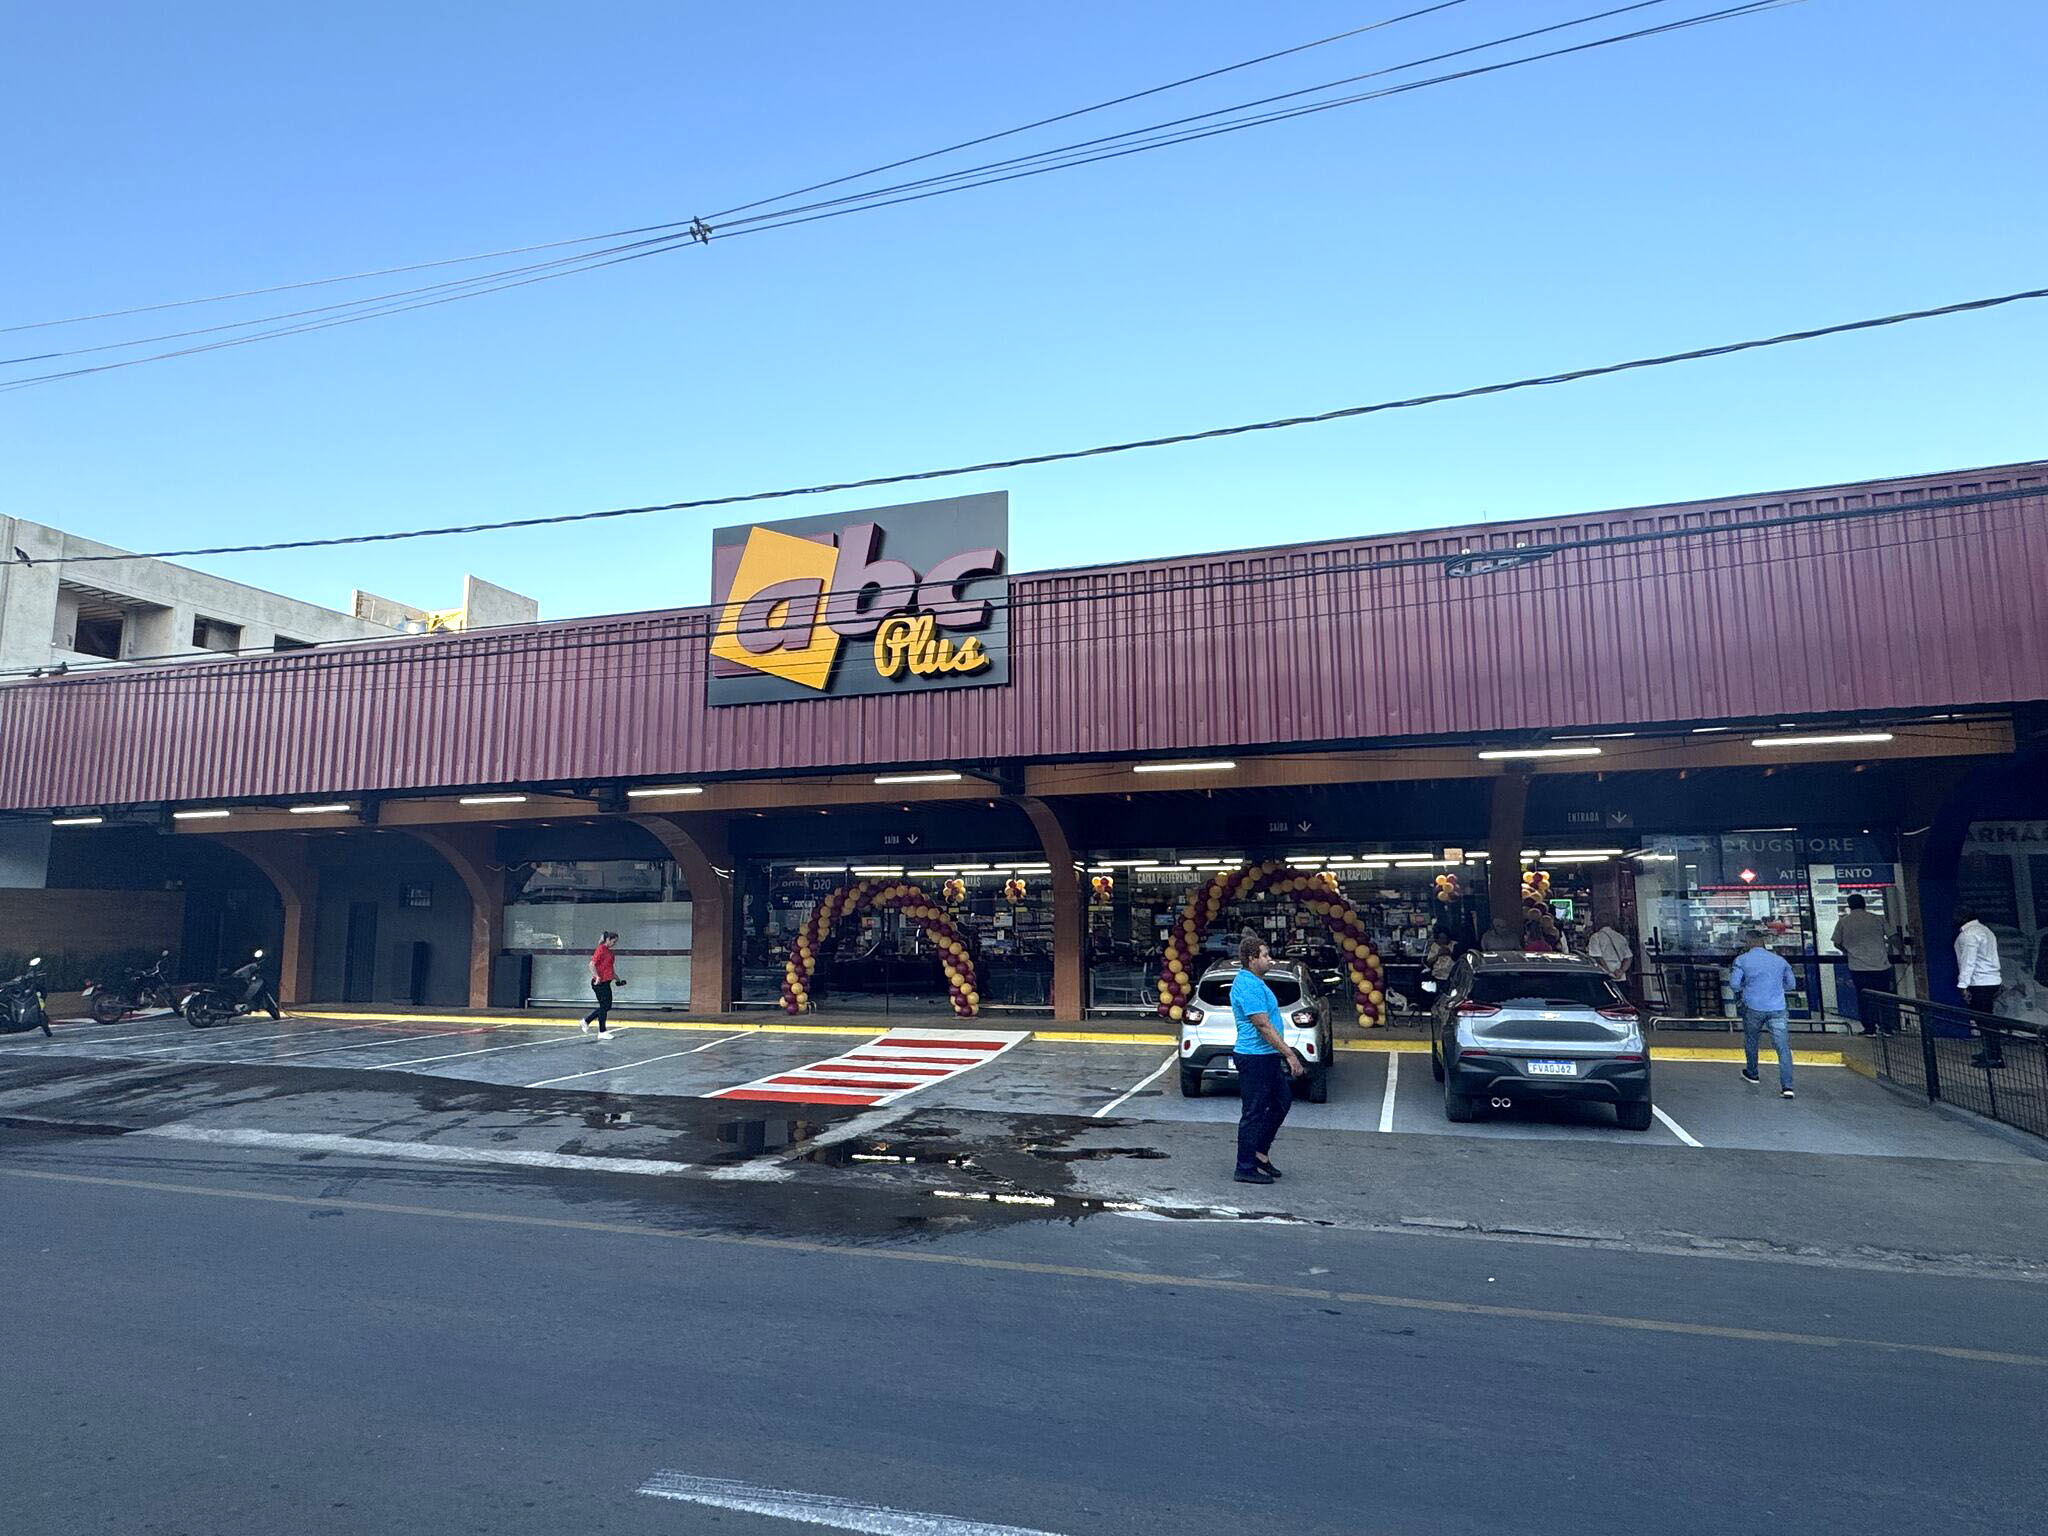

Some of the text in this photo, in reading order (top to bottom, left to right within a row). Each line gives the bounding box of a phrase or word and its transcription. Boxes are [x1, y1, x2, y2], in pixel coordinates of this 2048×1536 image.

[737, 522, 1004, 653] abc
[874, 613, 990, 679] Plus
[1568, 811, 1599, 823] ENTRADA
[1721, 837, 1856, 853] DRUGSTORE
